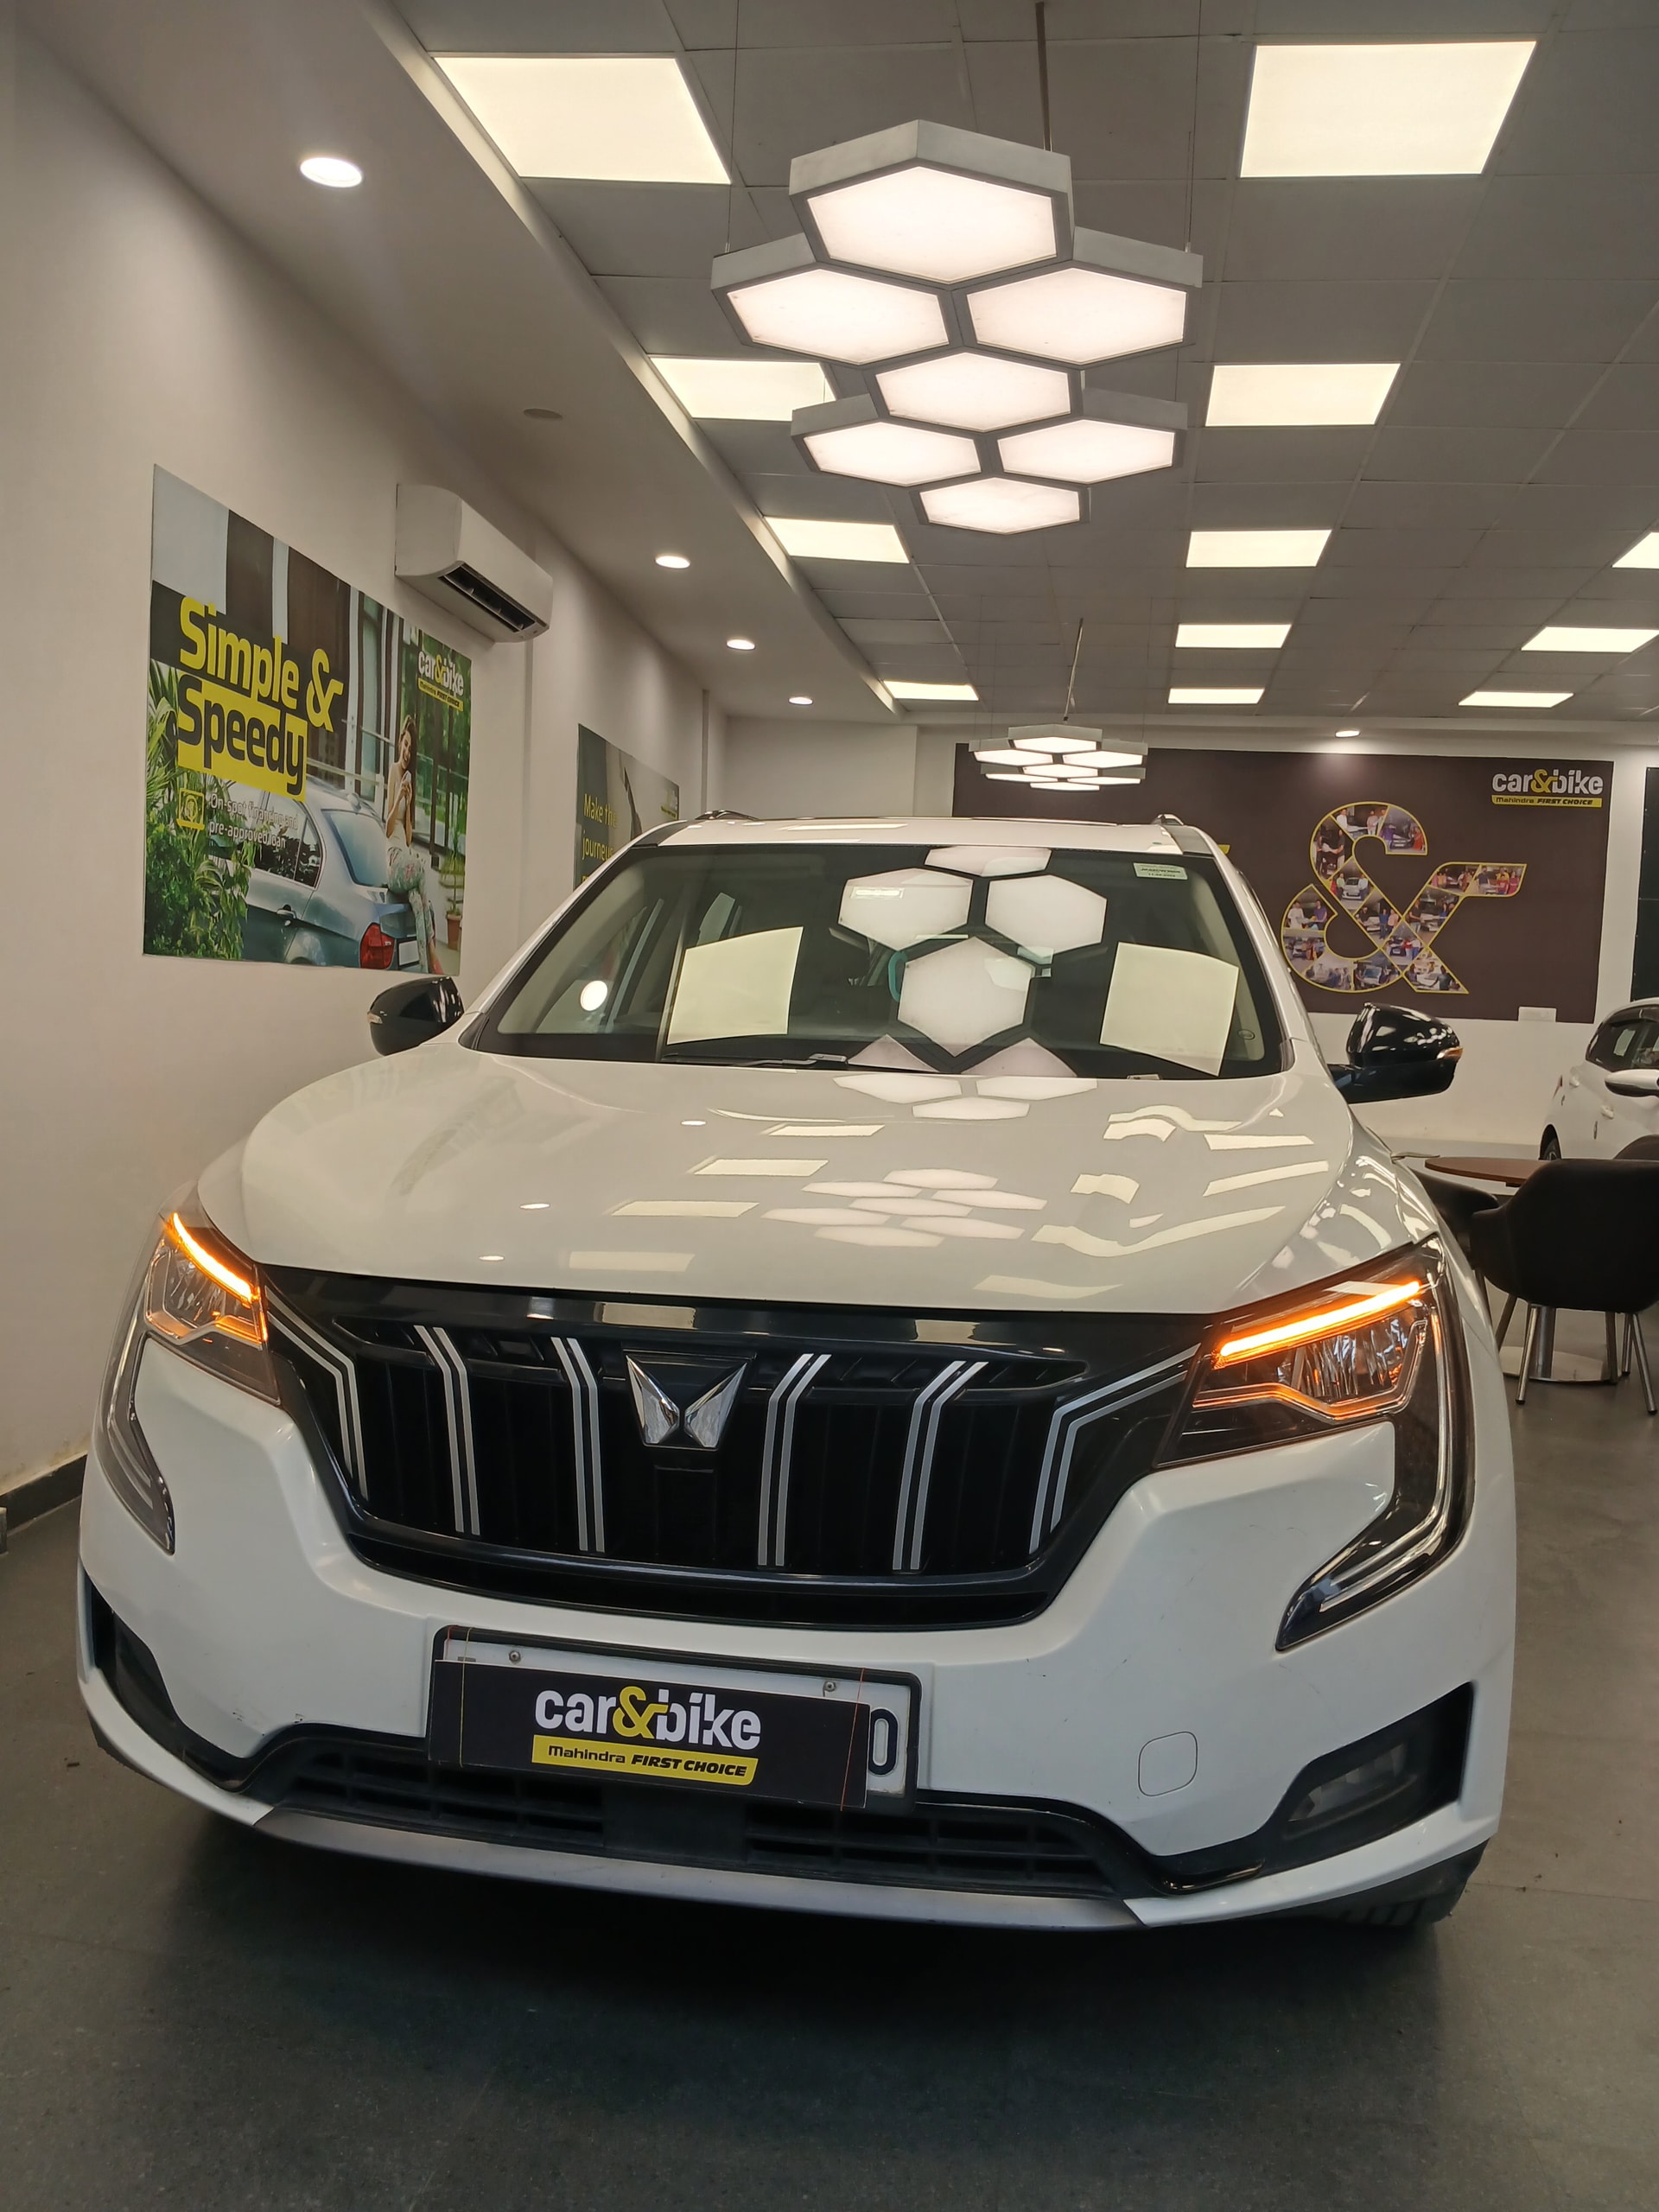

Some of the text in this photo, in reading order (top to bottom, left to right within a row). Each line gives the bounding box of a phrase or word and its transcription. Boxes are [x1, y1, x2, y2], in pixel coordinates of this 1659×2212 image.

[180, 596, 344, 733] Simple &
[418, 652, 464, 696] car&bike
[178, 674, 304, 795] Speedy
[1492, 769, 1604, 795] car&bike
[211, 793, 298, 830] On-spot financing and
[583, 793, 616, 829] Make the
[209, 821, 287, 849] pre-approved loan
[535, 1686, 761, 1751] car&bike
[548, 1745, 747, 1777] Mahindra FIRST CHOICE
